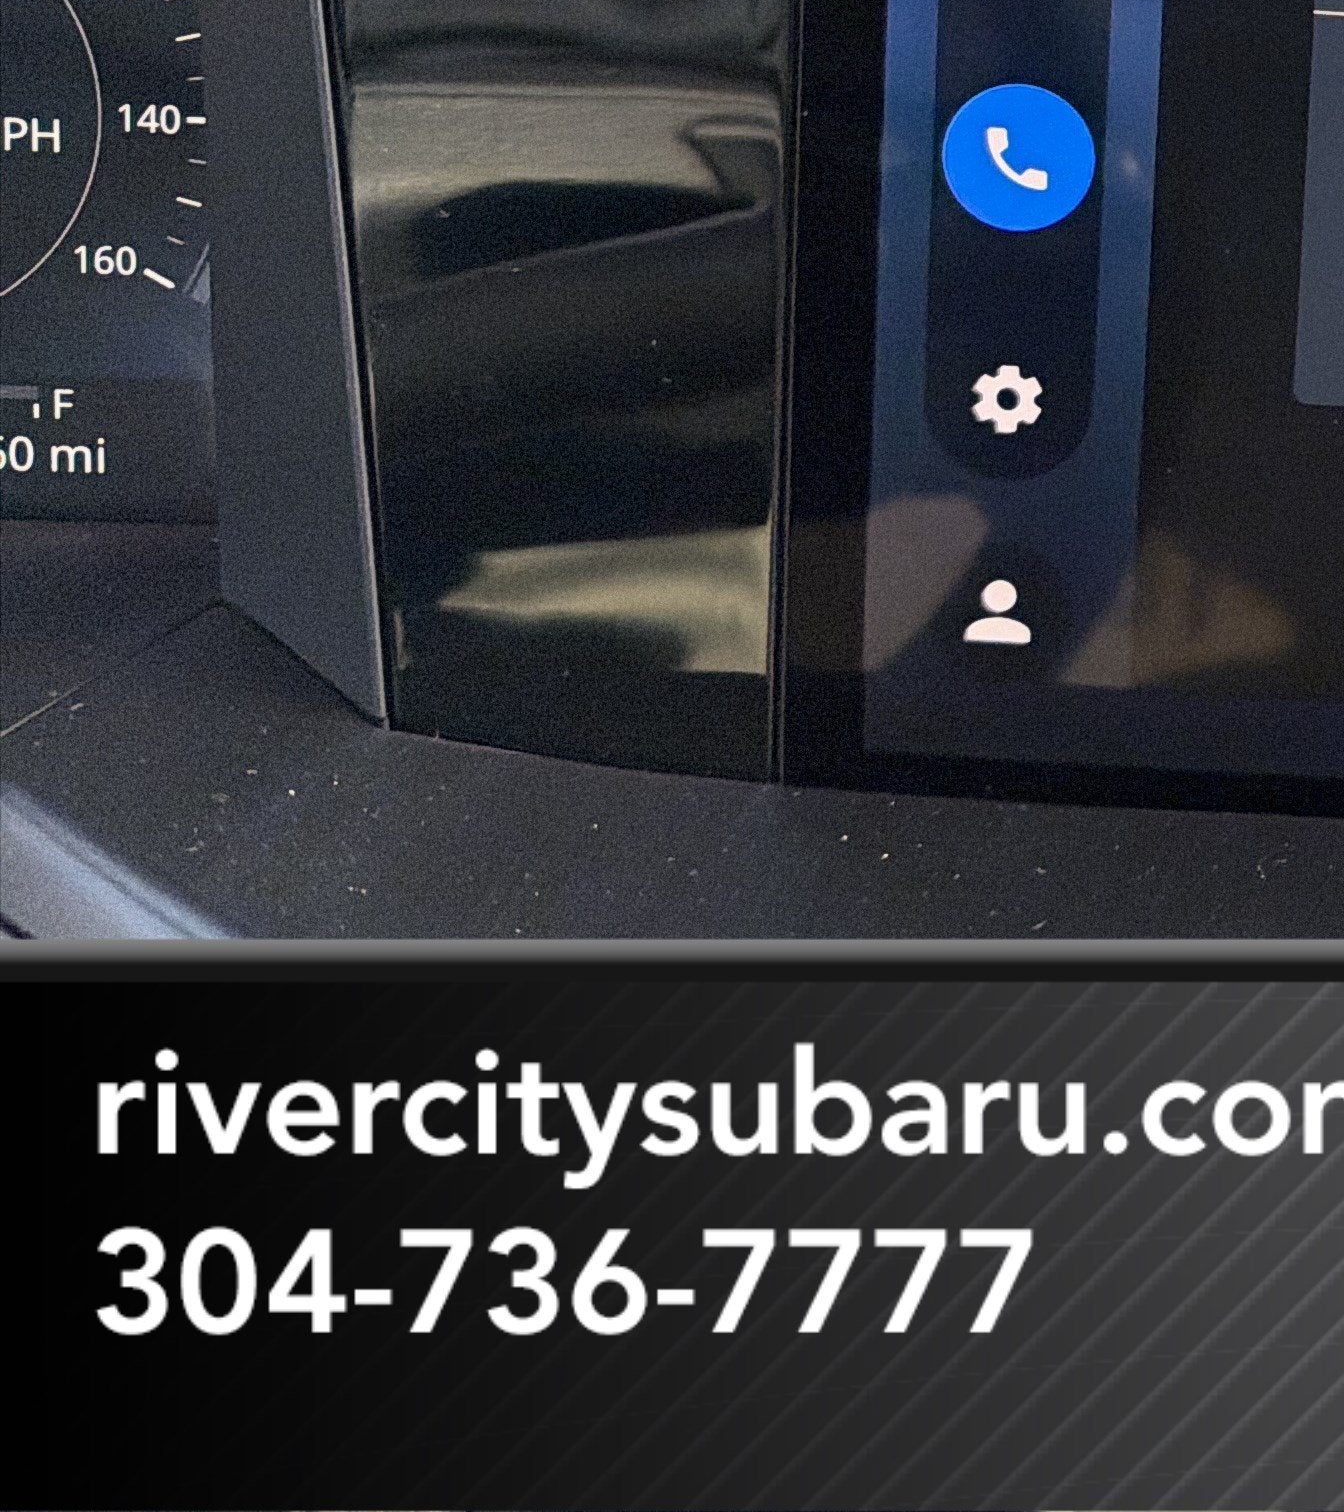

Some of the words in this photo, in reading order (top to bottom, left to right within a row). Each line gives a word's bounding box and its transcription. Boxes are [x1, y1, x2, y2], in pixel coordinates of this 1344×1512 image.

[118, 103, 181, 135] 140
[74, 244, 137, 276] 160
[53, 388, 74, 420] F
[0, 435, 35, 472] 0
[50, 437, 105, 474] mi
